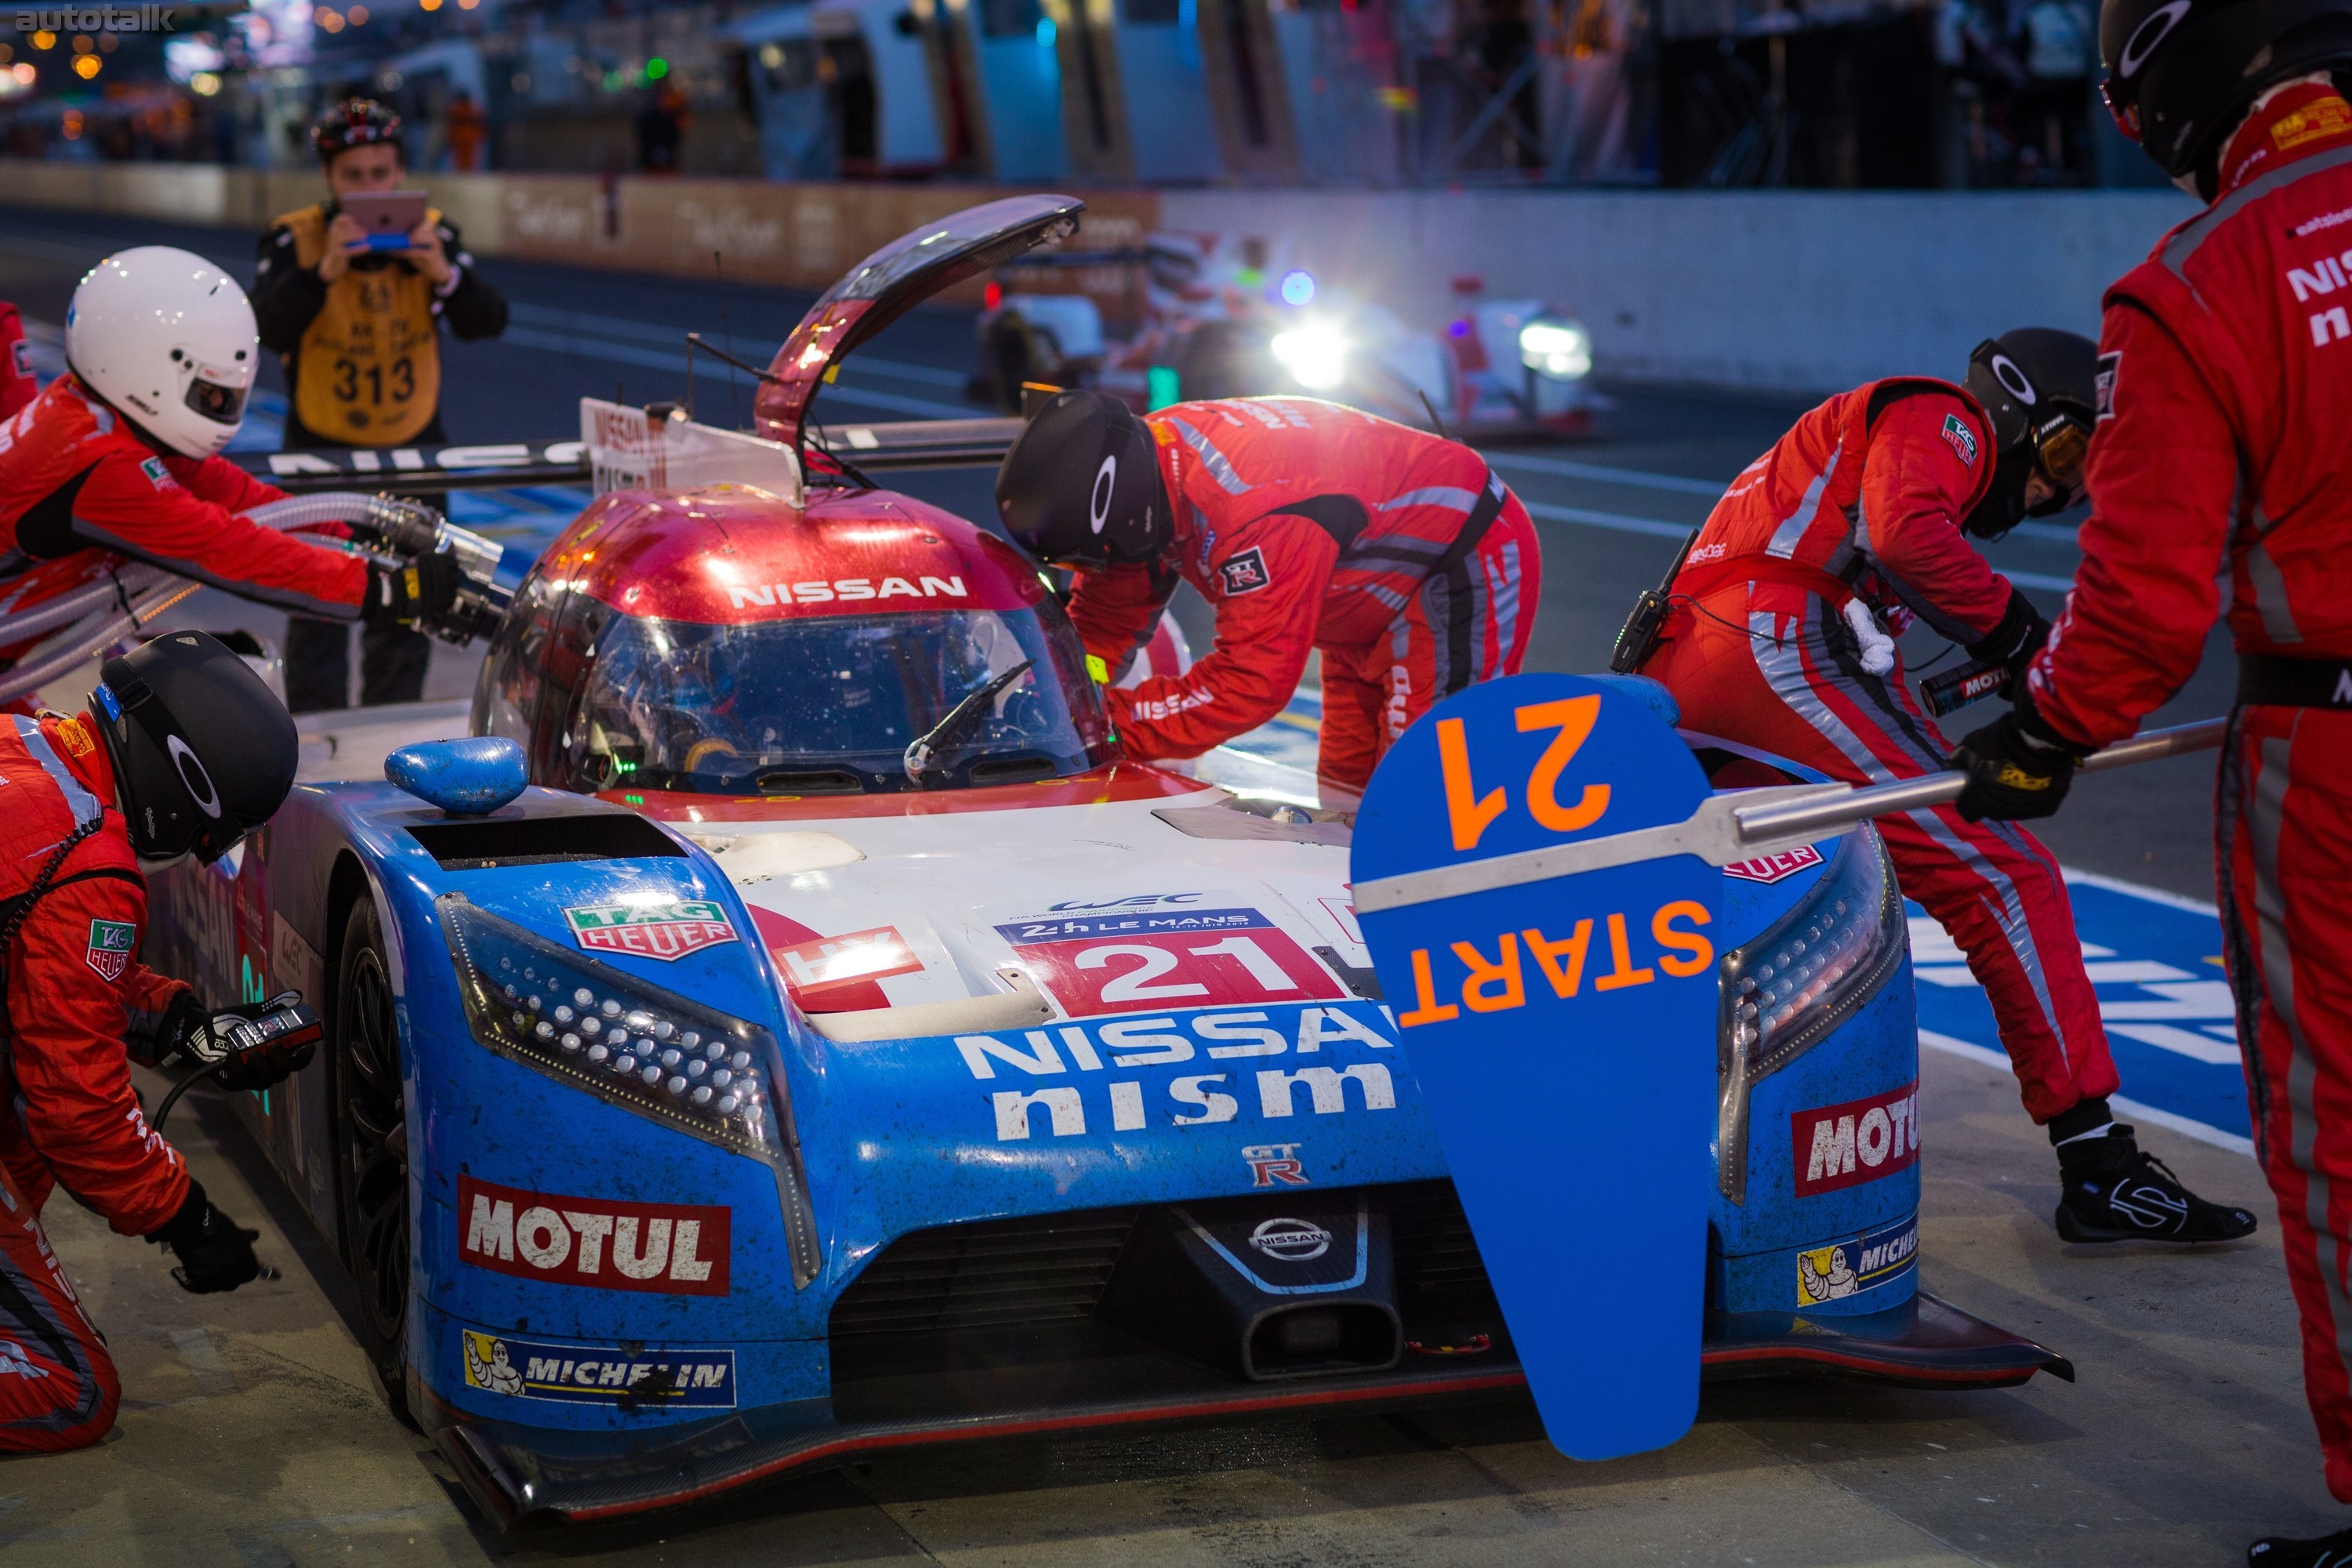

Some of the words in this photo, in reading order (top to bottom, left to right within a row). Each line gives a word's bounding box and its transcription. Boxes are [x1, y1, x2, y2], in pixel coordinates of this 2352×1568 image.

[334, 358, 415, 406] 313
[1955, 420, 1974, 452] TAG
[728, 575, 968, 609] NISSAN
[1436, 694, 1612, 851] 21
[1723, 848, 1813, 877] UER
[580, 903, 715, 926] TAG
[1047, 893, 1203, 912] WEC
[1062, 909, 1153, 918] CHAMPIONSHIP
[101, 927, 129, 948] TAG
[1099, 920, 1141, 931] LE
[1149, 915, 1250, 927] MANS
[587, 924, 729, 954] HEUER
[92, 950, 127, 975] HEUER
[1074, 936, 1303, 1004] 21
[1399, 900, 1715, 1029] START
[954, 1005, 1406, 1080] NISSA
[1242, 1142, 1301, 1160] GT
[1247, 1158, 1312, 1187] R
[466, 1193, 713, 1281] MOTUL
[1257, 1233, 1324, 1246] NISSAN
[525, 1356, 727, 1388] MICHEIN
